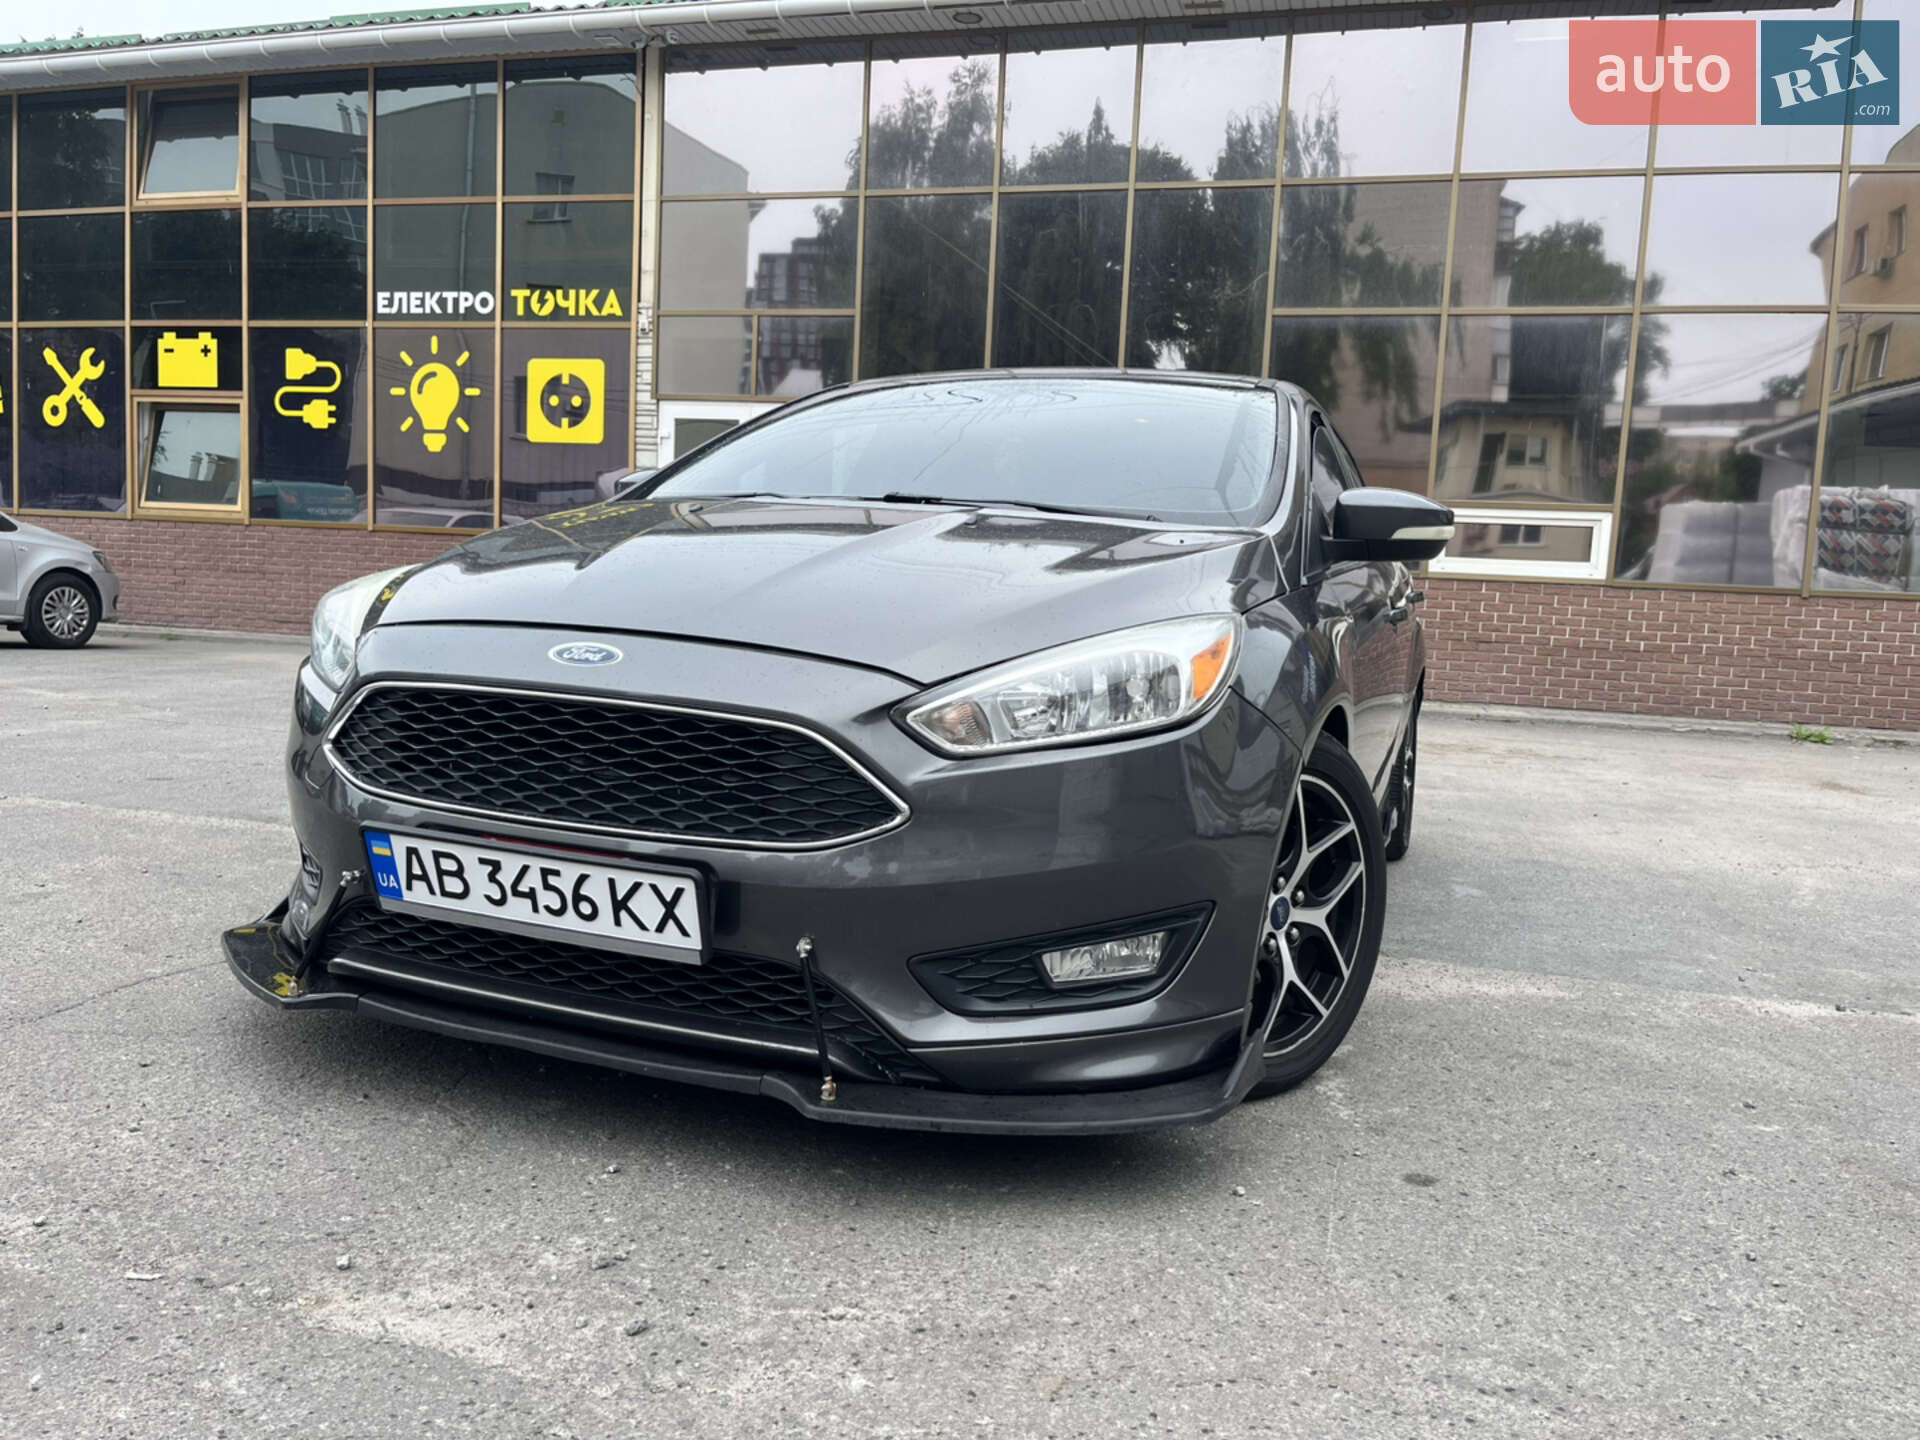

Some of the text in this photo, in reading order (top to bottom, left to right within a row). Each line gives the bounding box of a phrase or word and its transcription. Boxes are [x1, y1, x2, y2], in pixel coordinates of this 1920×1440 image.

[376, 289, 623, 316] ЕЛЕКТРО ТОЧКА
[377, 871, 399, 889] UA
[405, 846, 692, 938] AB 3456 KX
